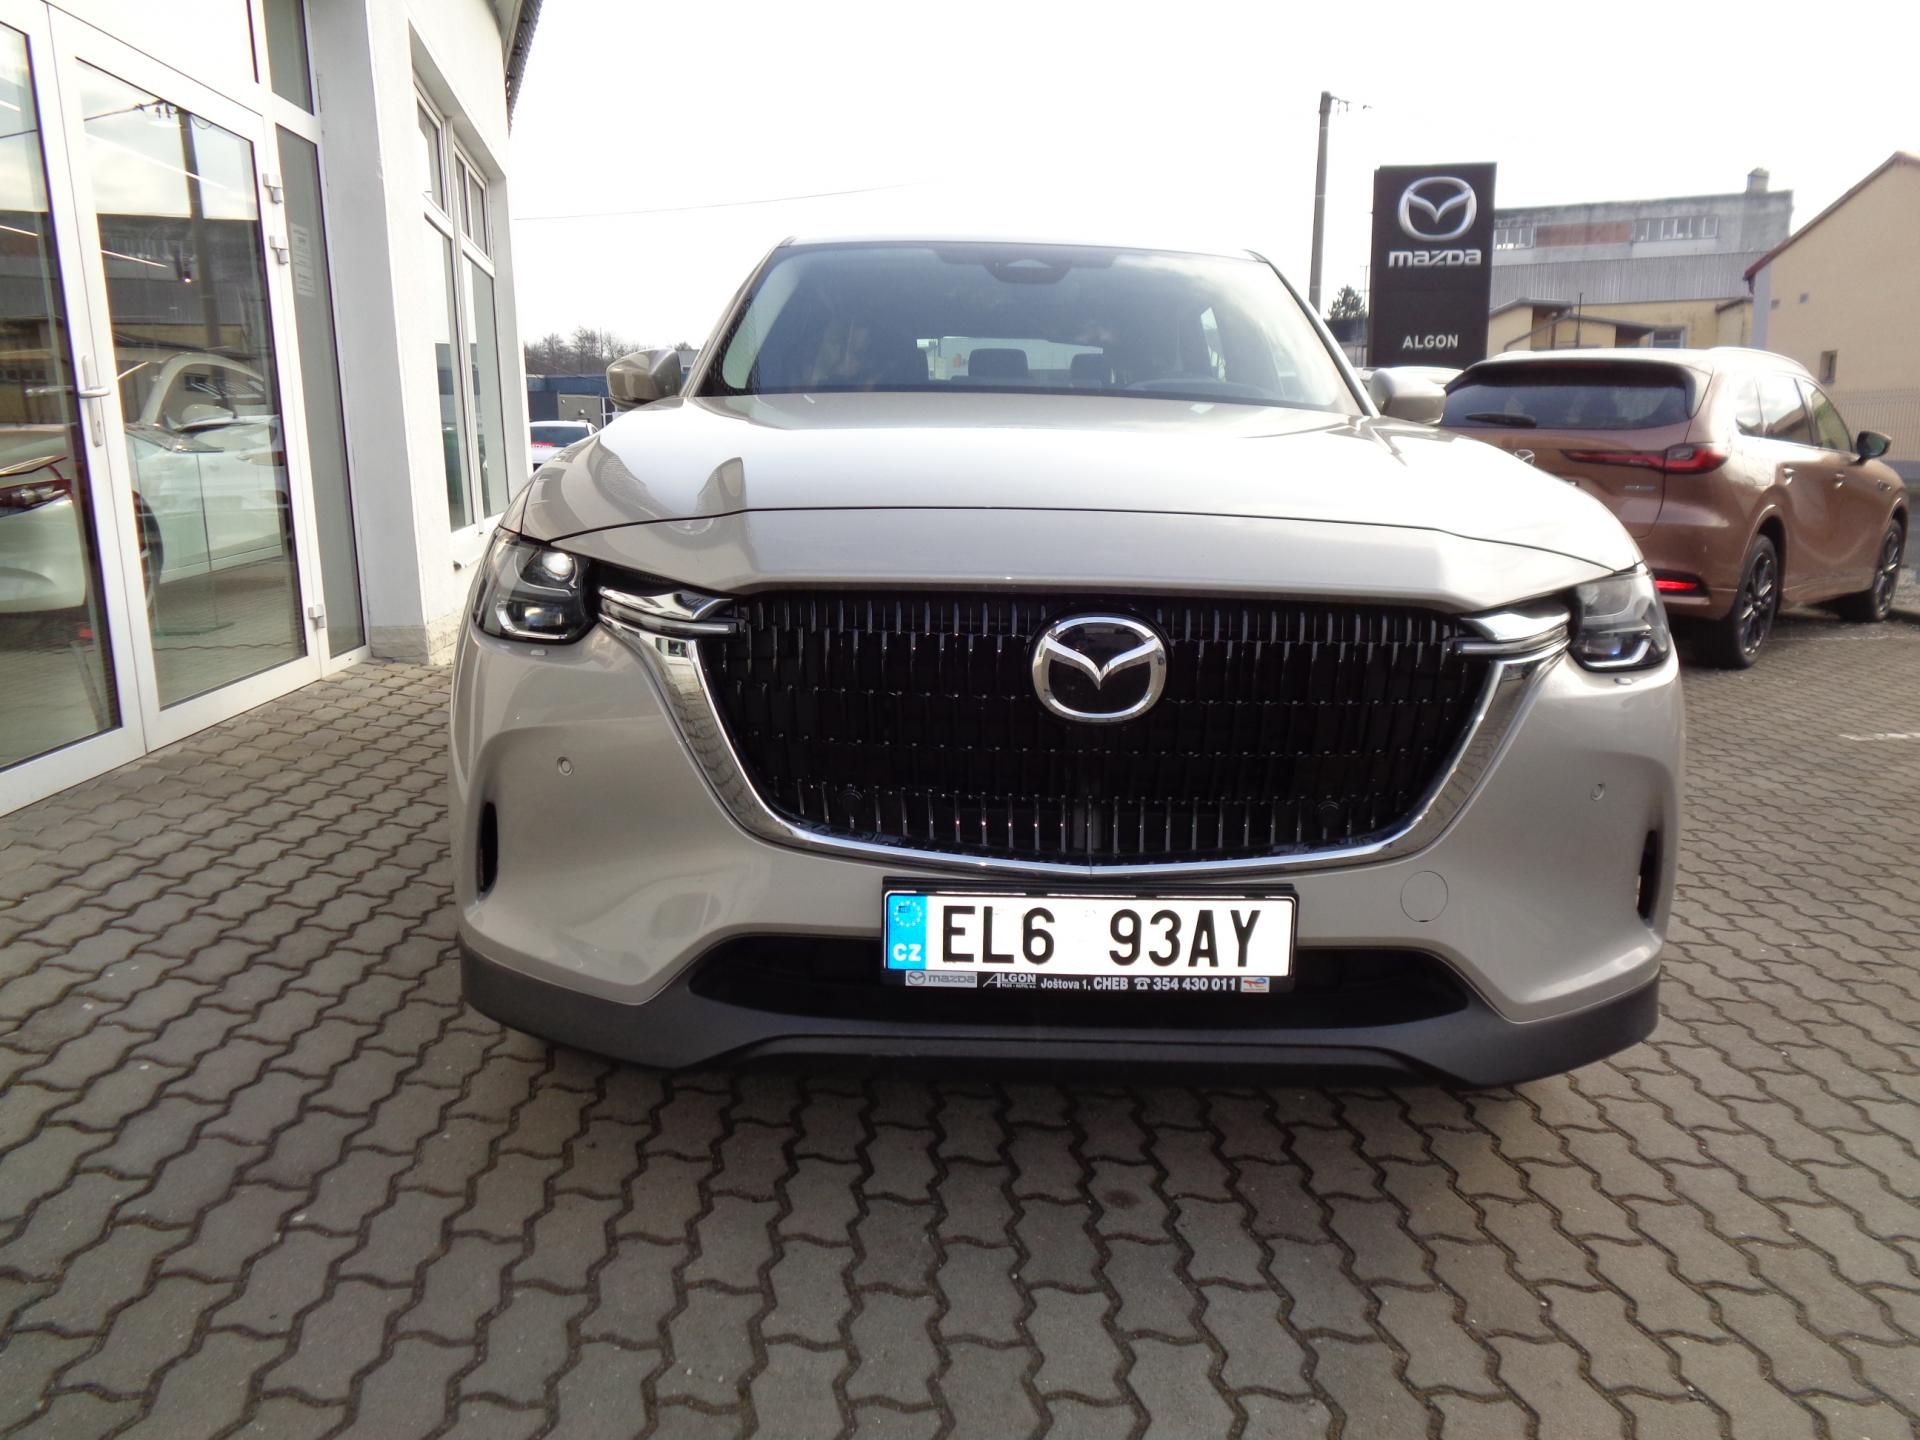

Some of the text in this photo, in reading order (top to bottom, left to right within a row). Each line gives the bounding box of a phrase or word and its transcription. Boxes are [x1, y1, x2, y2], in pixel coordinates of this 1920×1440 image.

[1402, 334, 1459, 349] ALGON
[942, 905, 1261, 968] EL6 93AY
[893, 943, 922, 962] CZ
[982, 972, 1037, 988] ALGON
[1040, 977, 1080, 990] Joštova
[1093, 976, 1129, 990] CHEB
[1152, 976, 1179, 991] 354
[1182, 976, 1209, 991] 430
[1211, 977, 1236, 991] 011
